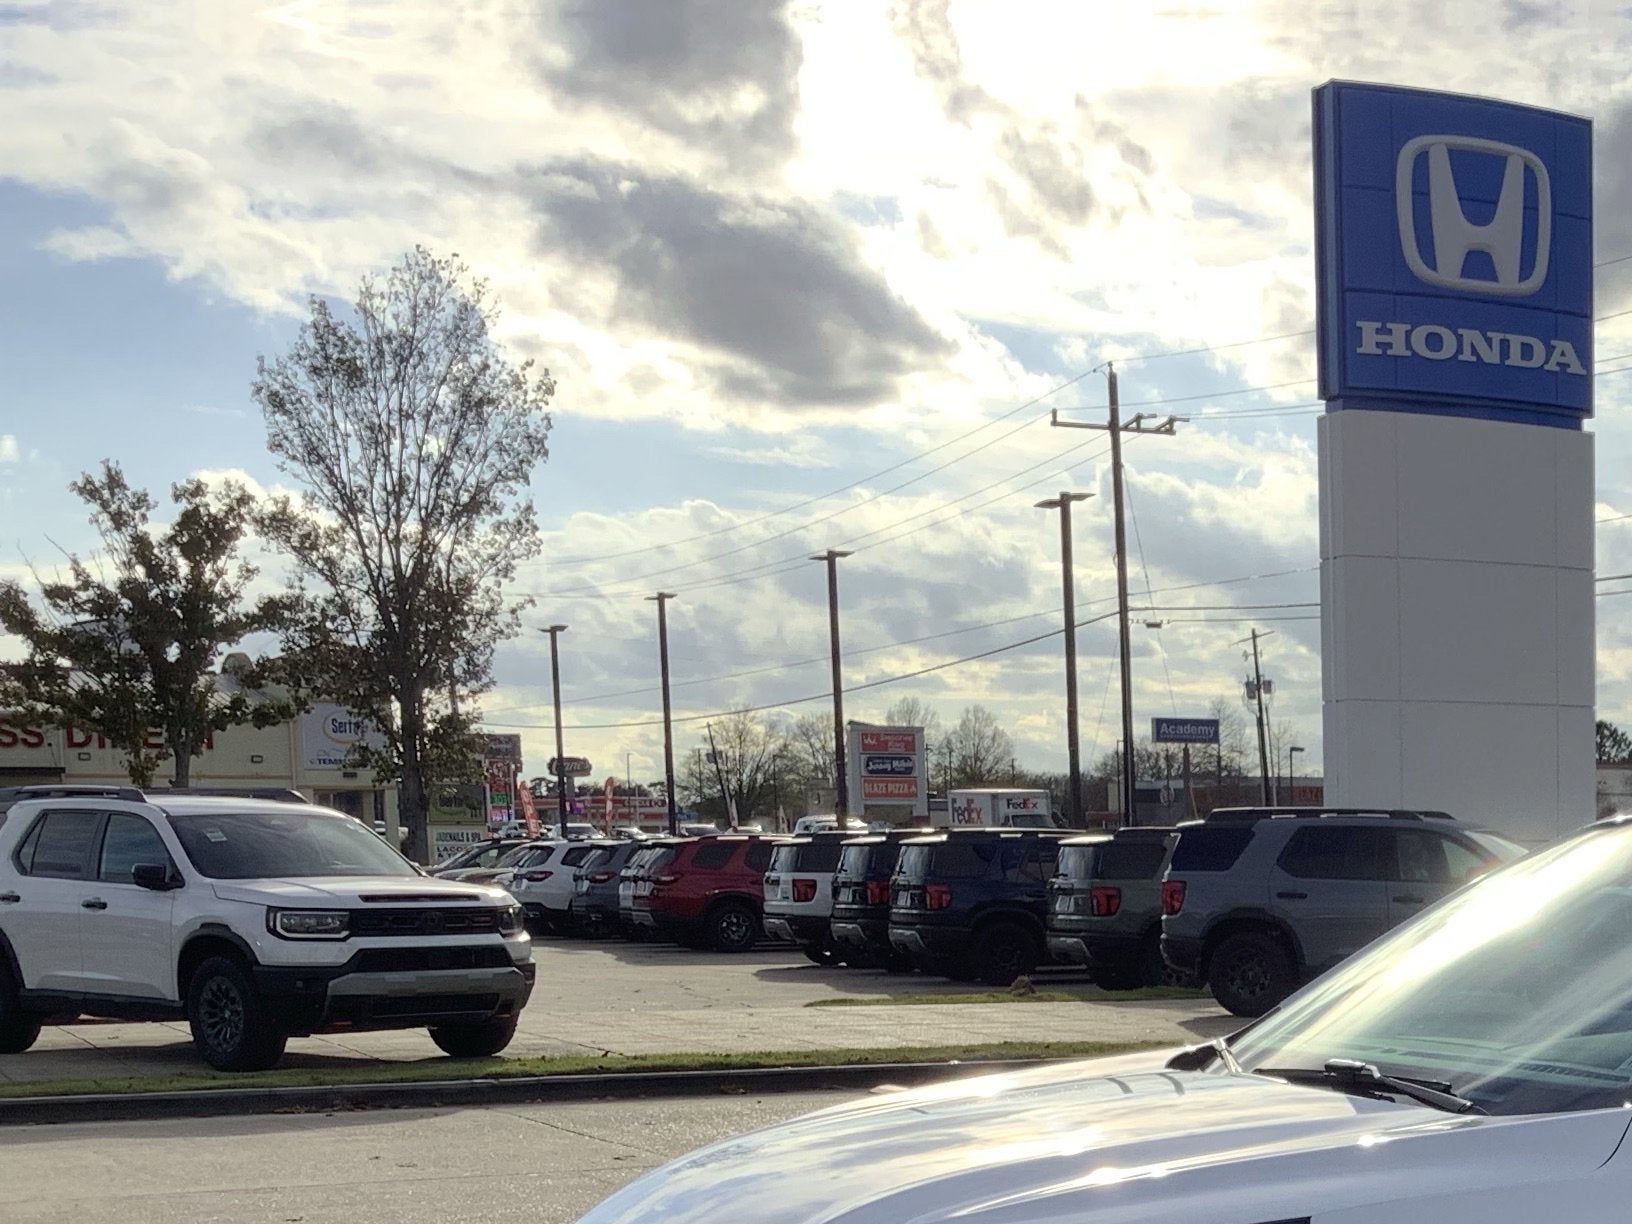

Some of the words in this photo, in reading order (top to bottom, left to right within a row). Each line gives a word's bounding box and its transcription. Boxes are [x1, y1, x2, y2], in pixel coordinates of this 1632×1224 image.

[1356, 320, 1587, 375] HONDA
[331, 719, 363, 734] Sert
[1160, 723, 1215, 738] Academy
[888, 782, 909, 793] PIZZA
[951, 797, 983, 824] FedEx
[1007, 798, 1038, 809] FedEx
